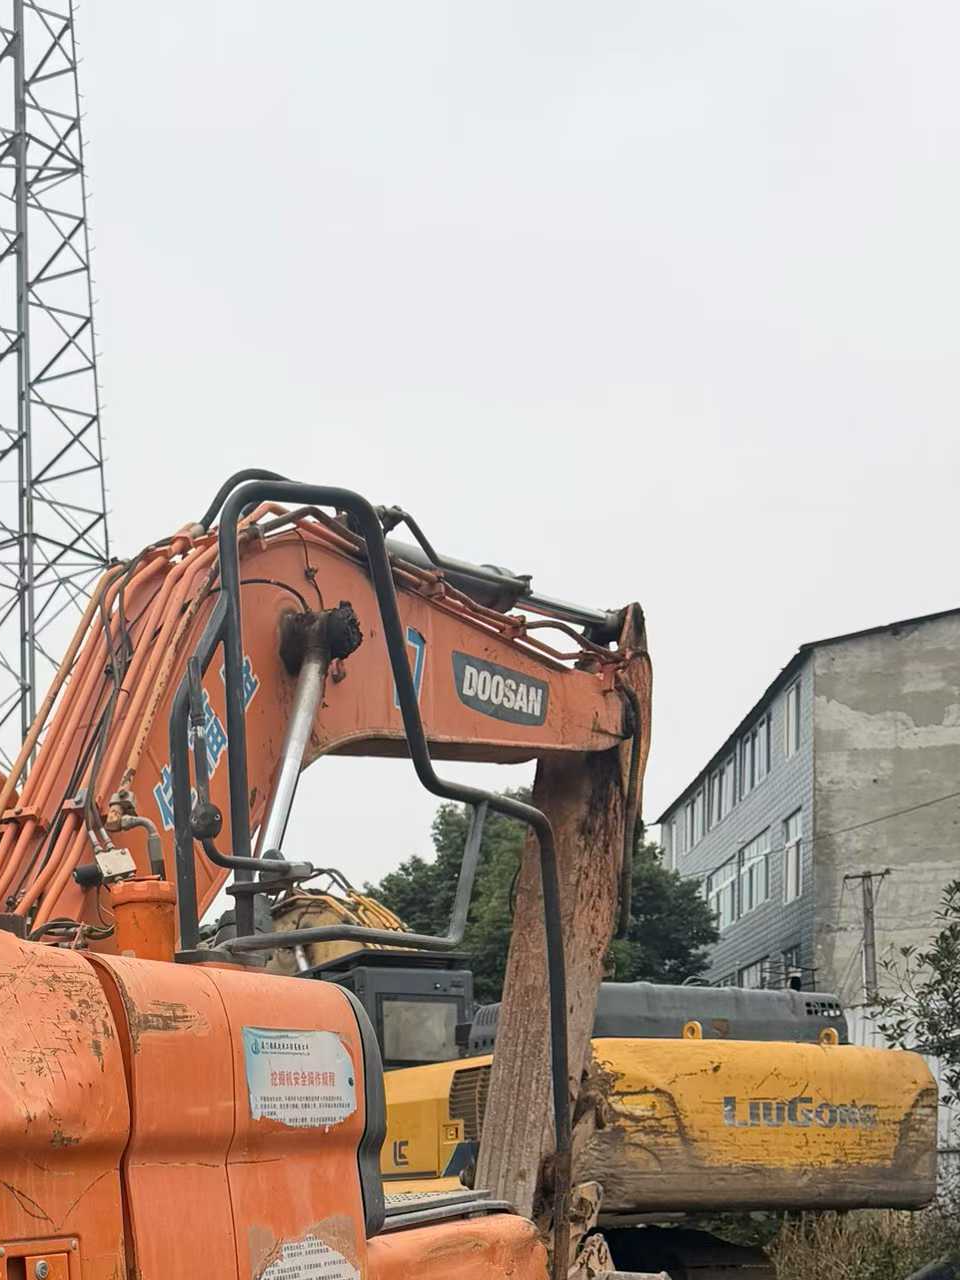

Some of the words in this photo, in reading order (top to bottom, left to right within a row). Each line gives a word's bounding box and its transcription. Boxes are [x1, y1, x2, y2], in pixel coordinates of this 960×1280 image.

[463, 665, 542, 716] DOOSAN
[270, 1071, 336, 1087] 挖掘机安全操作规程
